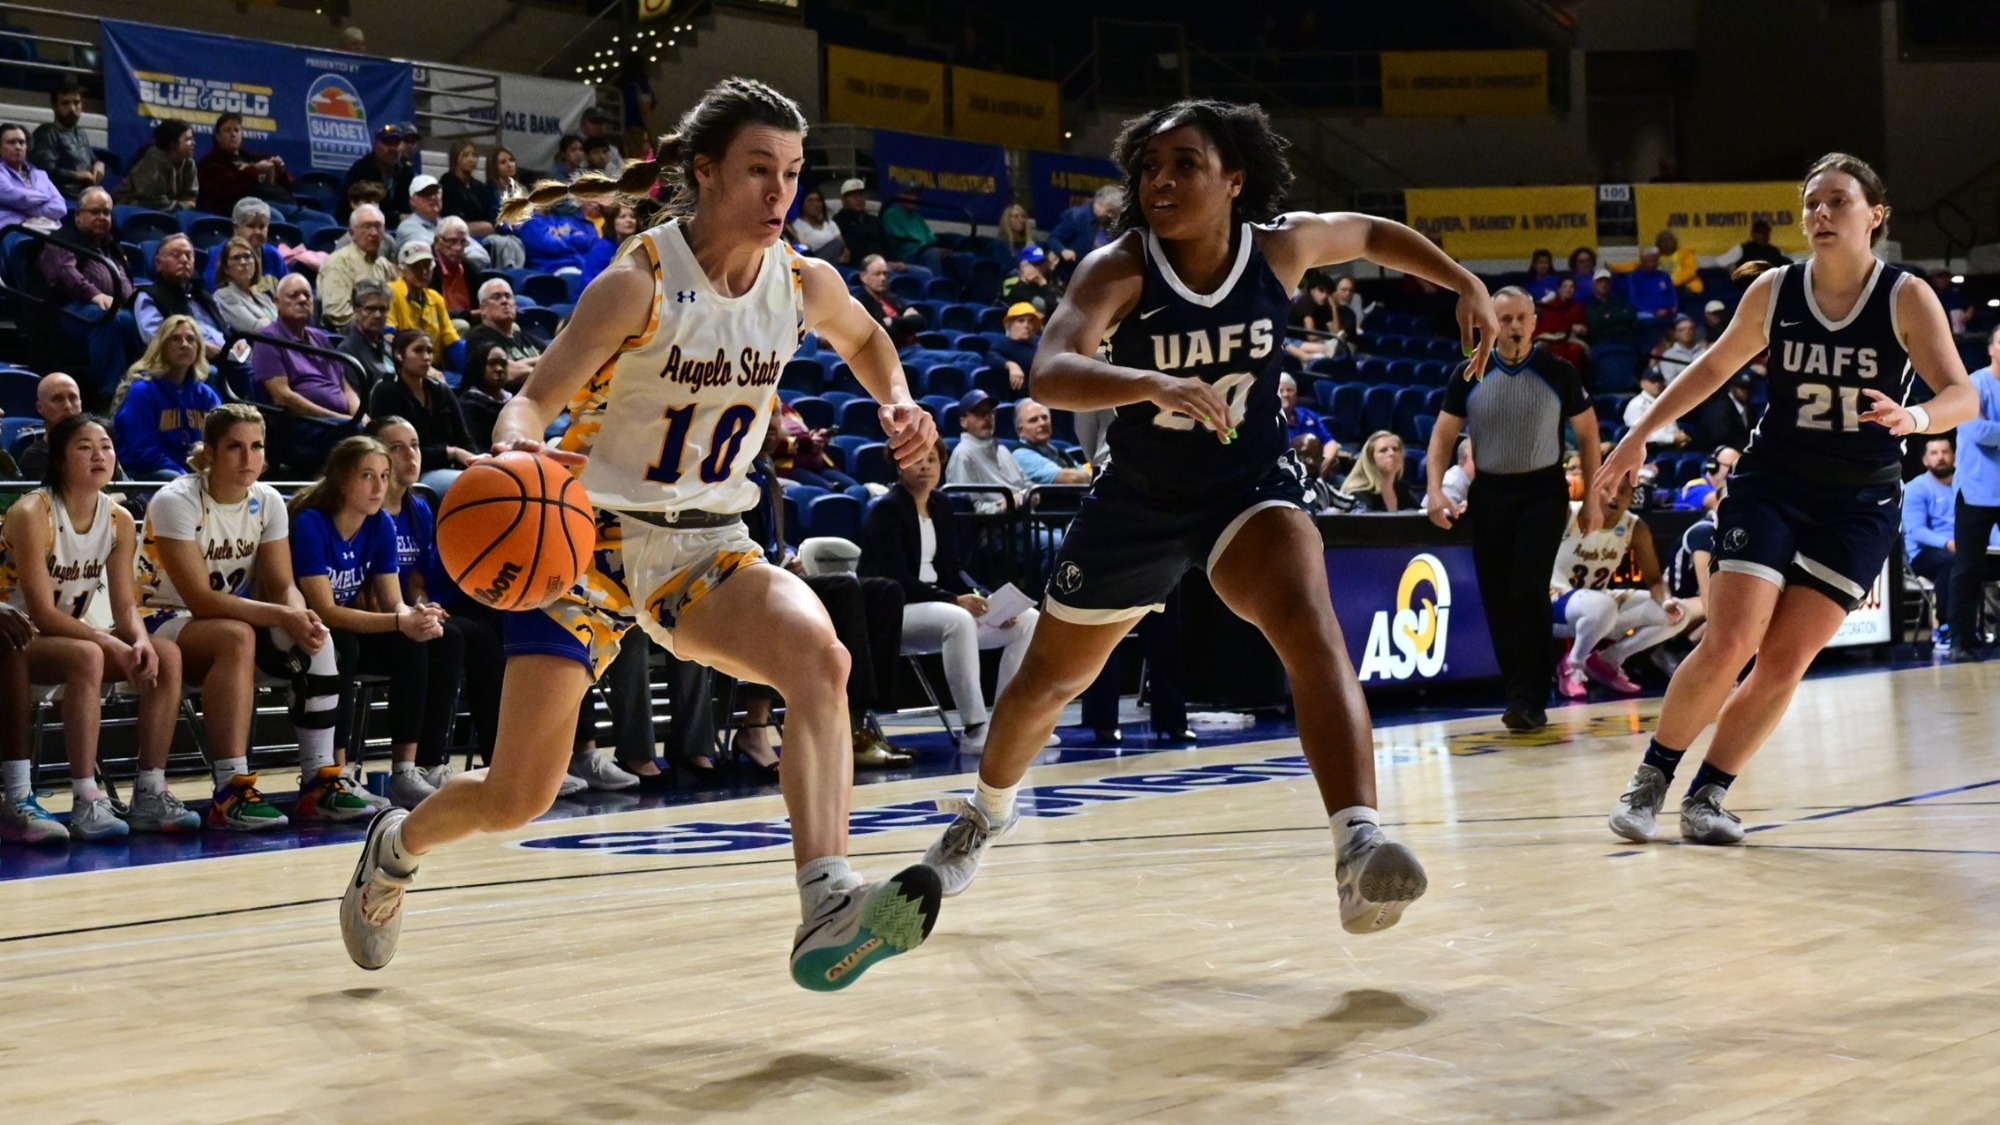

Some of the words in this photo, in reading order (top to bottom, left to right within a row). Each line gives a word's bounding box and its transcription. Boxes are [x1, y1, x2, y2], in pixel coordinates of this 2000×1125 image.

[139, 80, 198, 109] BLUE
[211, 90, 269, 116] GOLD
[311, 119, 364, 140] SUNSET
[530, 113, 562, 135] BANK
[1151, 318, 1273, 370] UAFS
[1783, 340, 1878, 379] UAFS
[660, 345, 732, 394] Angelo
[738, 347, 780, 387] State
[1796, 383, 1860, 432] 21
[645, 402, 758, 484] 10
[47, 554, 80, 584] Angelo
[472, 562, 524, 604] lson
[1569, 564, 1610, 590] 32
[1358, 607, 1450, 681] ASU
[518, 755, 1308, 856] Stephen
